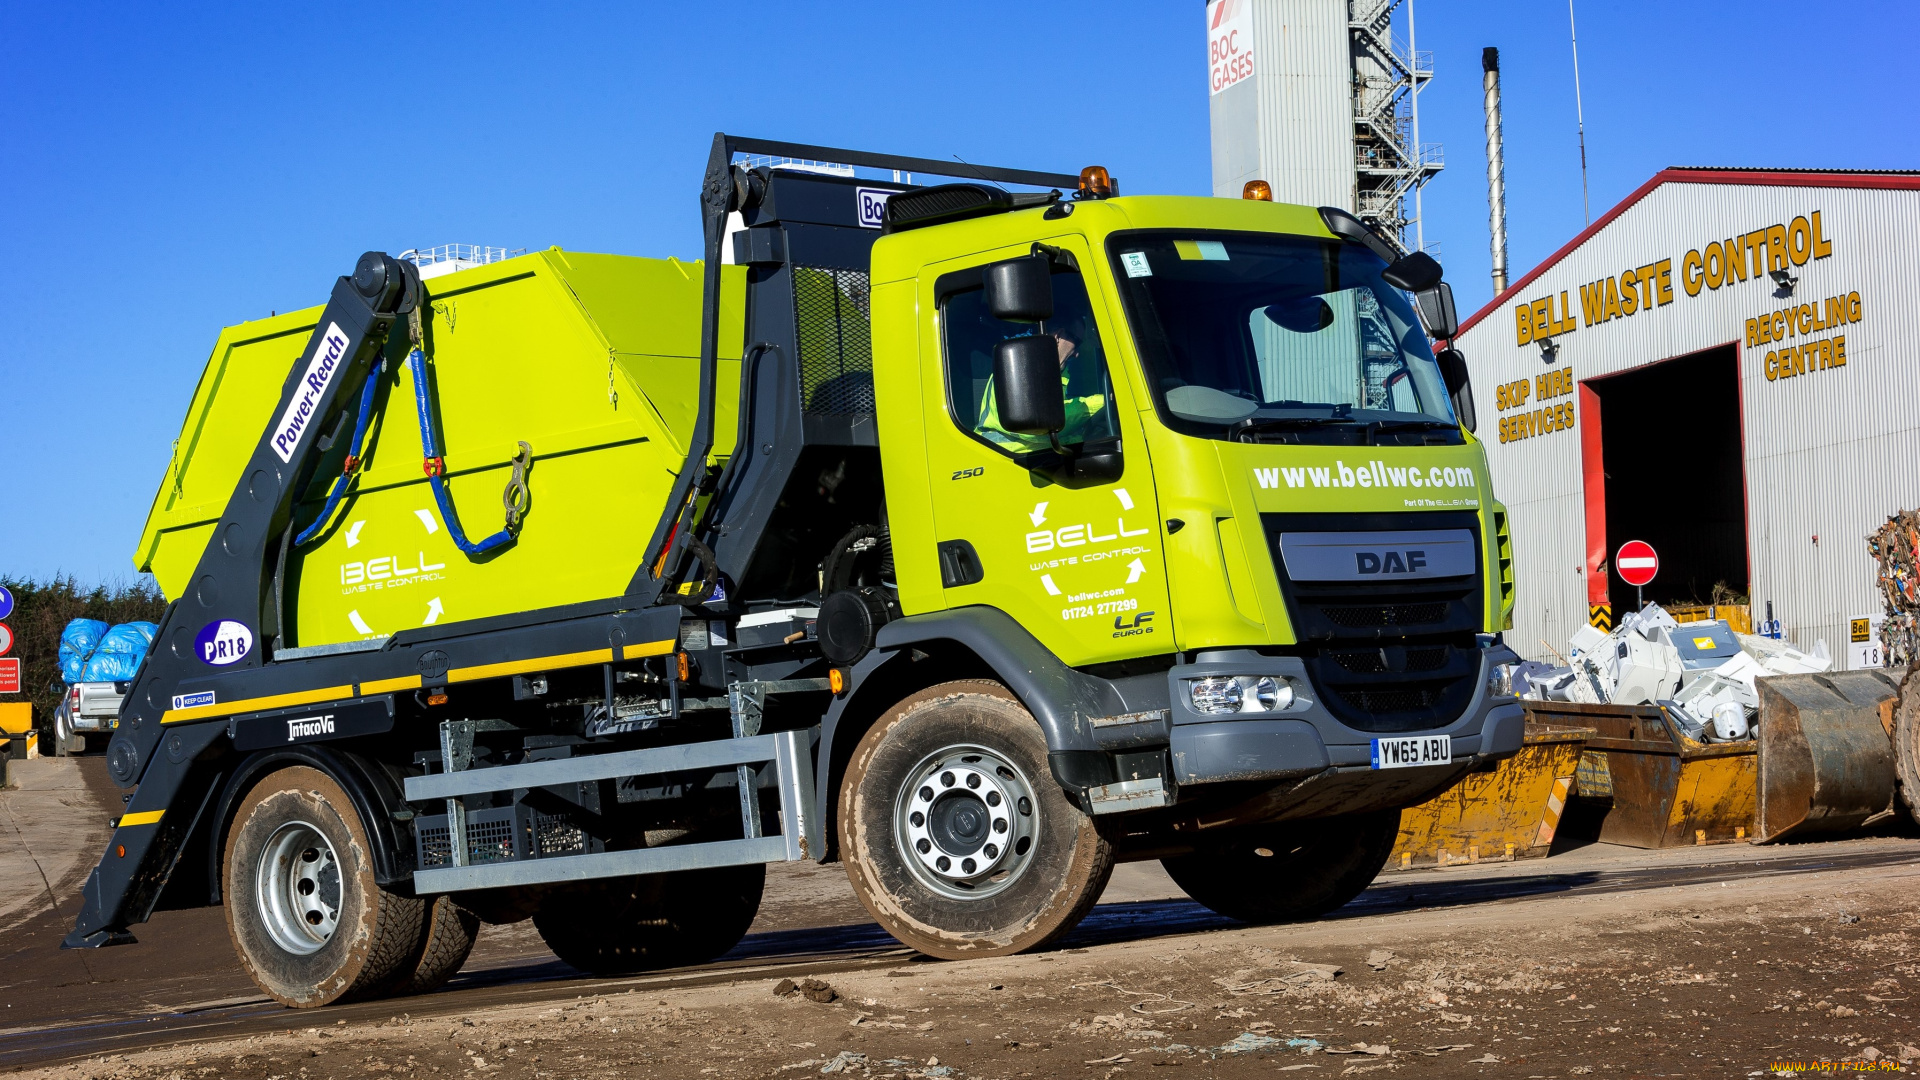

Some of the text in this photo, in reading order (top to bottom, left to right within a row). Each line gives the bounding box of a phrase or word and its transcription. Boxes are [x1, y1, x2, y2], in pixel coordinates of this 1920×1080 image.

[1211, 30, 1238, 66] BOC
[1212, 51, 1253, 91] GASES
[1516, 210, 1832, 347] BELL WASTE CONTROL
[1746, 290, 1862, 348] RECYCLING
[1764, 335, 1847, 382] CENTRE
[276, 334, 344, 455] Power-Reach
[1496, 366, 1574, 412] SKIP HIRE
[1498, 400, 1575, 444] SERVICES
[952, 466, 984, 480] 250
[1254, 460, 1475, 488] www.bellwc.com
[1465, 498, 1478, 506] Group
[1026, 518, 1149, 554] BELL
[340, 551, 445, 585] BELL
[1030, 546, 1151, 571] WASTE CONTROL
[1355, 550, 1426, 574] DAF
[342, 573, 446, 595] WASTE CONTROL
[1068, 588, 1124, 603] bellwc.com
[1062, 598, 1138, 620] 01724 277299
[1114, 611, 1155, 630] LF
[1112, 628, 1144, 638] EURO
[1852, 621, 1868, 633] Bell
[204, 637, 245, 660] PR18
[1872, 648, 1878, 663] 8
[287, 715, 334, 741] IntacoVa
[1382, 739, 1448, 764] YW65 ABU
